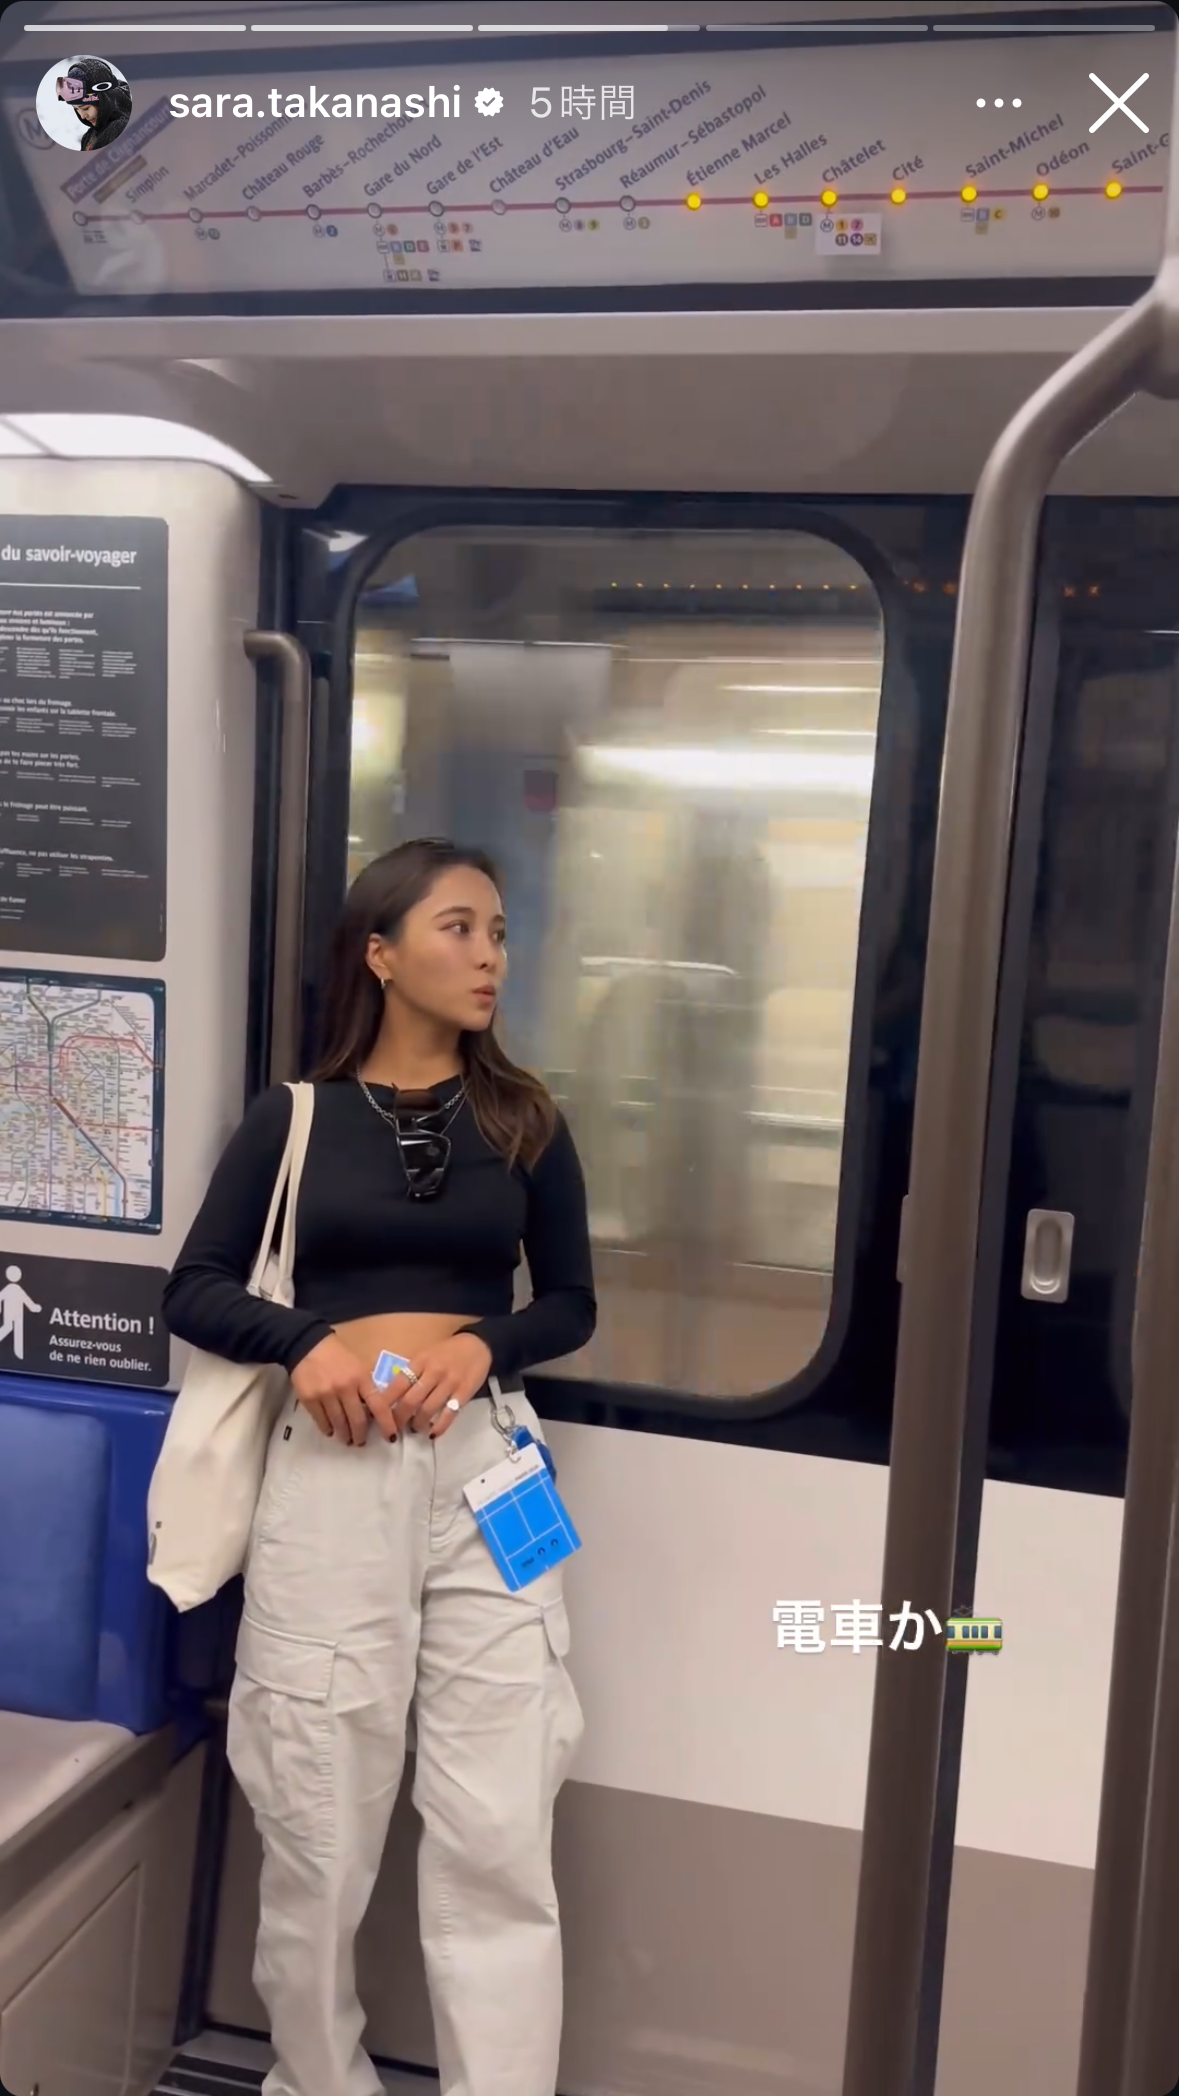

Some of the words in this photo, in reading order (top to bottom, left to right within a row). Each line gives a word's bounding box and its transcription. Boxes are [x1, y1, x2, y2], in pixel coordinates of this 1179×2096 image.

[363, 172, 394, 197] Gare
[393, 160, 411, 177] du
[409, 134, 443, 165] Nord
[426, 169, 457, 195] Gare
[456, 157, 473, 175] de
[471, 136, 504, 164] l'Est
[489, 153, 542, 193] Château
[541, 127, 580, 158] d'Eau
[686, 146, 741, 187] Étienne
[740, 111, 792, 153] Marcel
[754, 163, 781, 185] Les
[780, 133, 828, 169] Halles
[821, 139, 887, 183] Châtelet
[965, 113, 1065, 178] Saint-Michel
[1036, 141, 1090, 176] Odéon
[125, 165, 170, 203] Simplon
[242, 162, 289, 200] Château
[286, 133, 325, 168] Rouge
[892, 154, 925, 181] Cité
[851, 234, 863, 245] 14
[1, 543, 21, 561] du
[25, 545, 137, 567] savoir-voyager
[49, 1307, 142, 1334] Attention
[148, 1316, 155, 1336] !
[49, 1335, 122, 1353] Assurez-vous
[49, 1349, 64, 1362] de
[66, 1352, 82, 1364] ne
[84, 1353, 107, 1367] rien
[109, 1358, 152, 1372] oublier.
